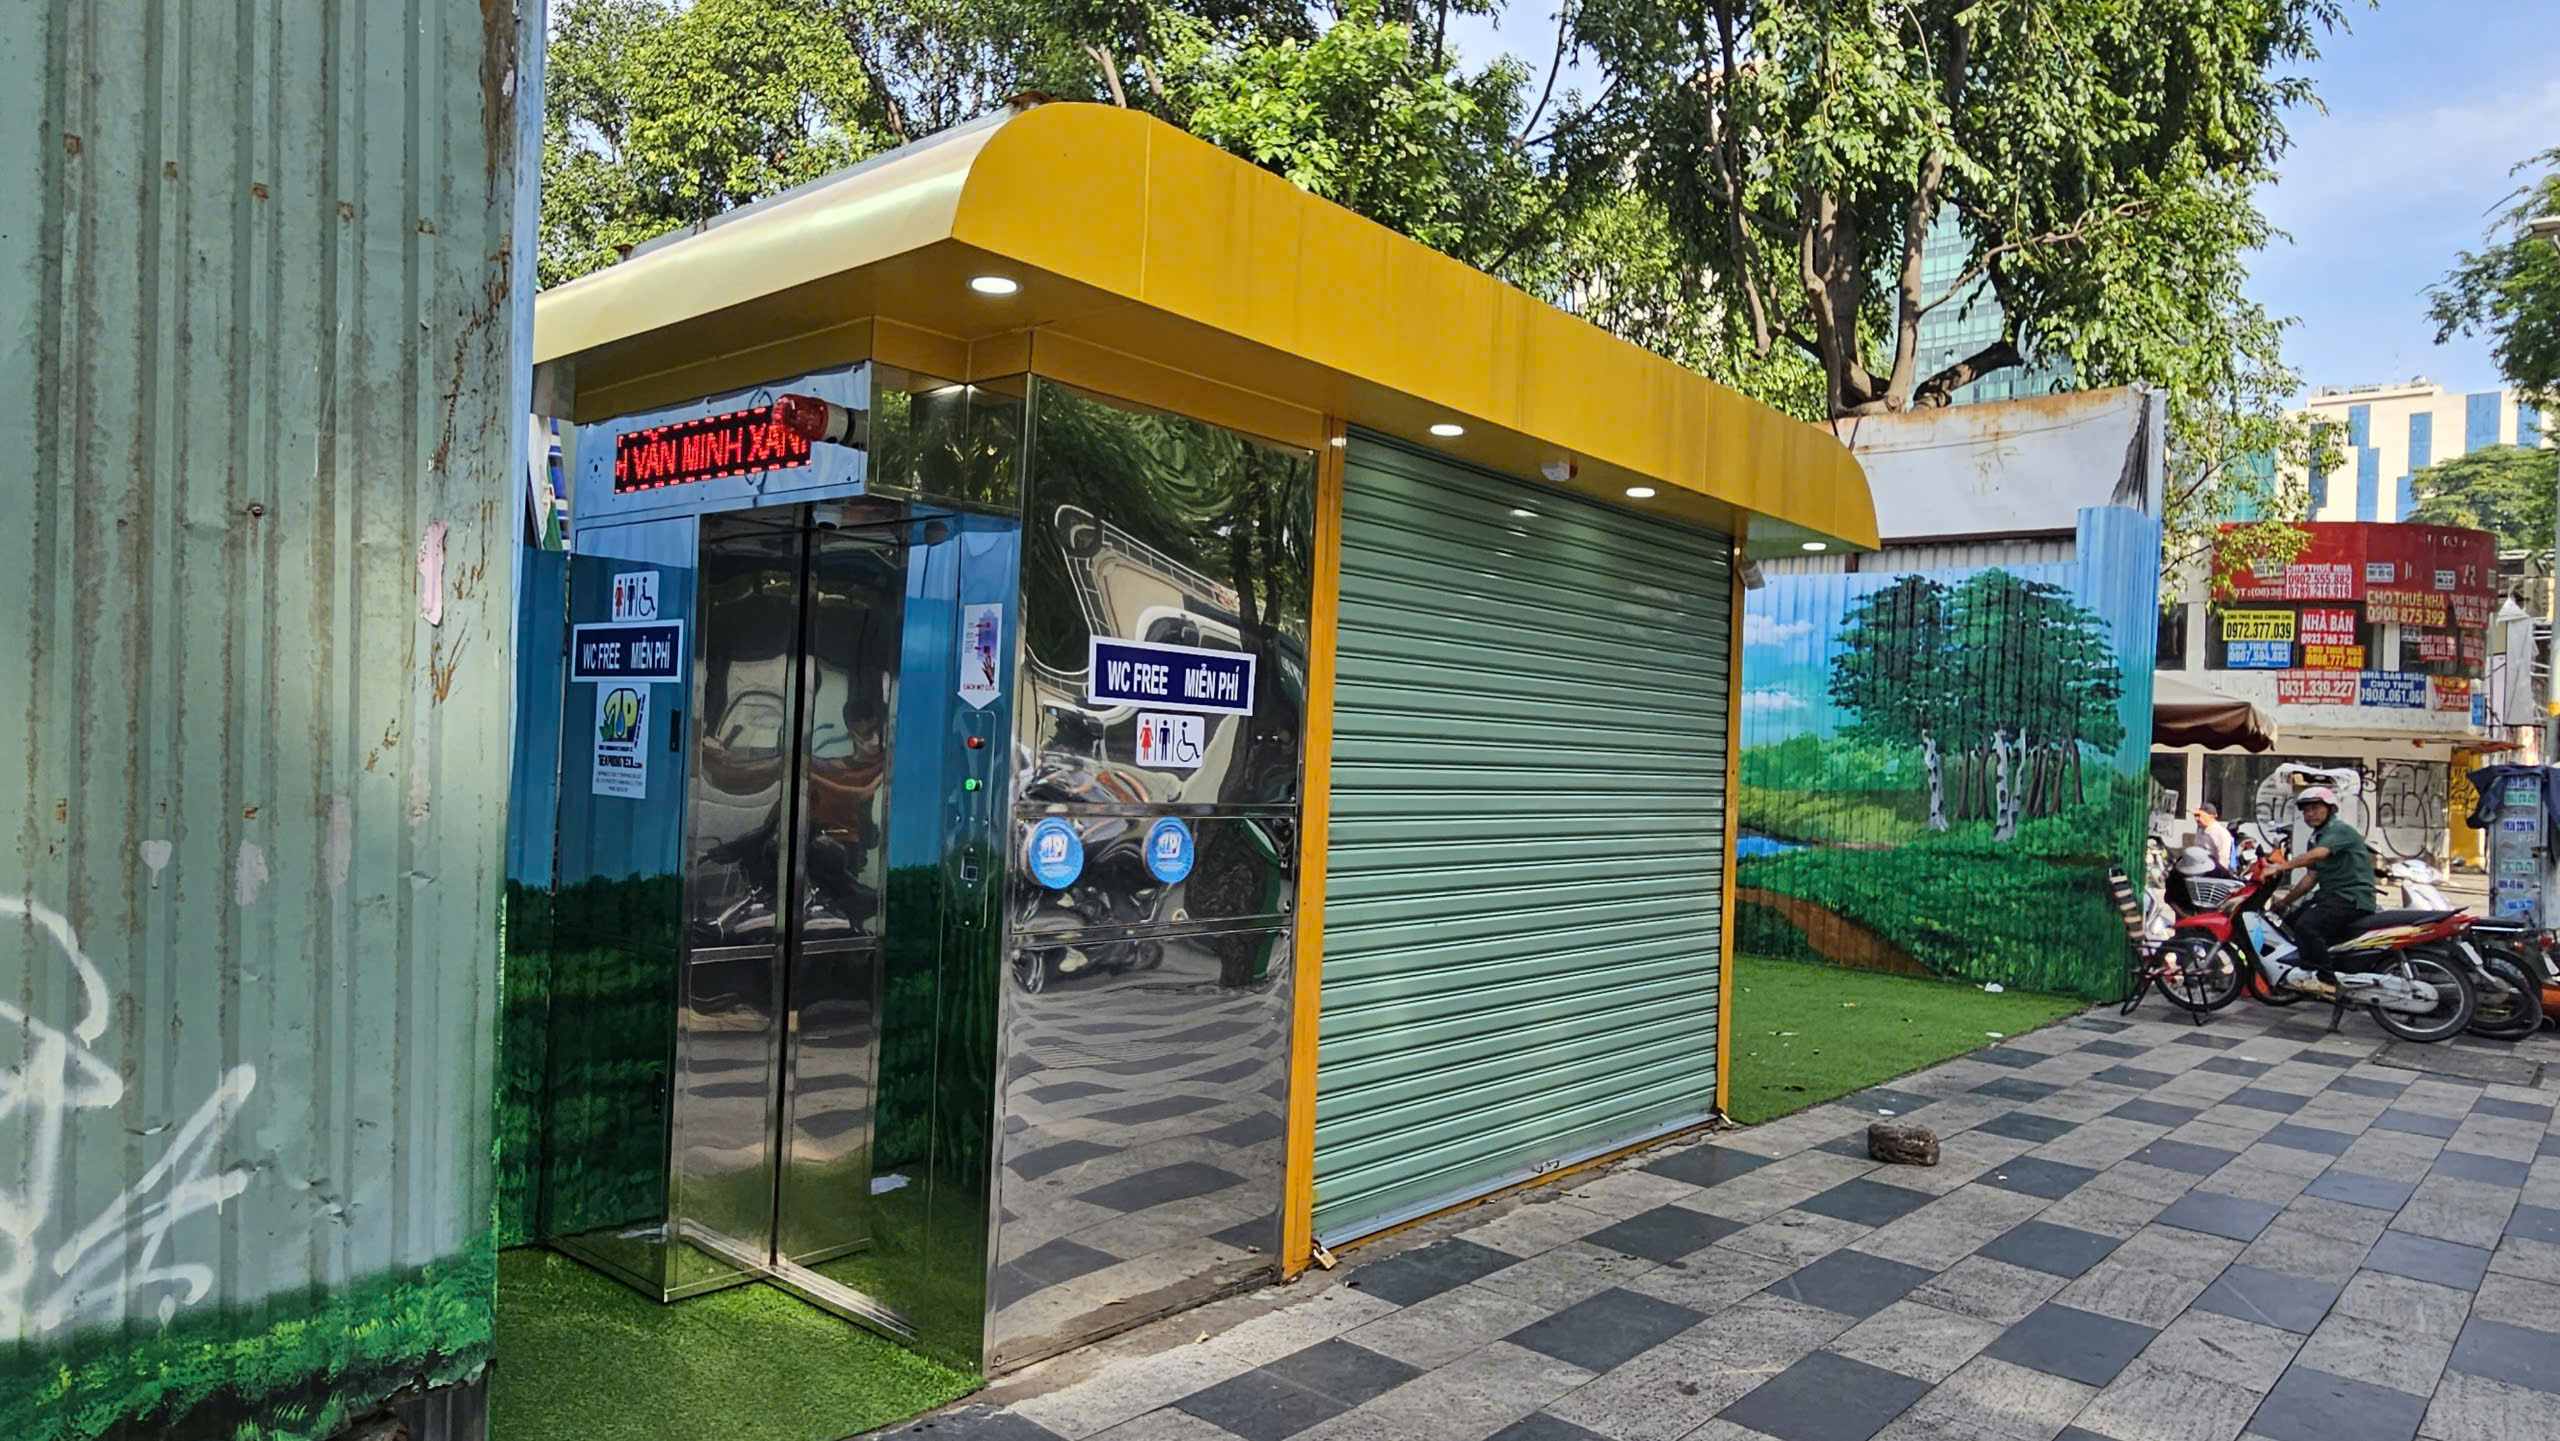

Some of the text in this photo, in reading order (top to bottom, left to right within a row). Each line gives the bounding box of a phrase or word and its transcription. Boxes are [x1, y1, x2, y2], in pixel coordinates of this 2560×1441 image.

[681, 427, 744, 472] MINH
[2366, 589, 2393, 605] CHO
[2394, 589, 2423, 607] THUÊ
[2301, 609, 2354, 632] NHÀ BÁN
[2366, 605, 2399, 622] 0908
[2400, 607, 2423, 624] 875
[2425, 609, 2446, 625] 399
[2226, 622, 2292, 639] 0972.377.039
[583, 642, 597, 670] WC
[598, 641, 621, 670] FREE
[654, 632, 671, 669] PHÍ
[1107, 660, 1131, 693] WC
[1133, 662, 1169, 696] FREE
[1217, 665, 1240, 702] PHÍ
[2370, 680, 2391, 689] CHO
